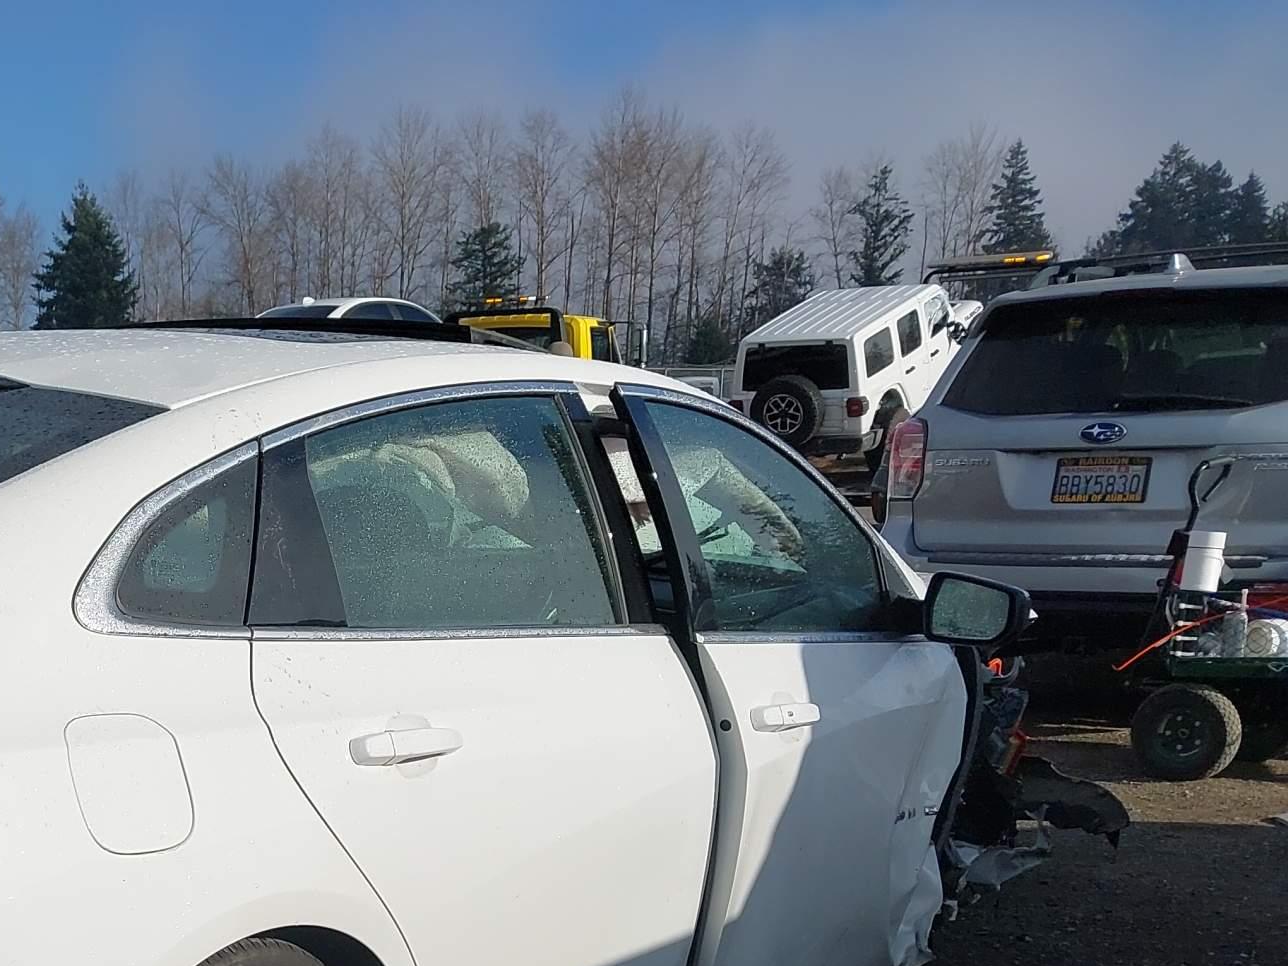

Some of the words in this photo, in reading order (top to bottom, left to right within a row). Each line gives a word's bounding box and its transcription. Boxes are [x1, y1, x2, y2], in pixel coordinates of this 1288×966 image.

[935, 458, 990, 467] SUBARU
[1053, 494, 1089, 503] SUBARU
[1091, 494, 1103, 503] OF
